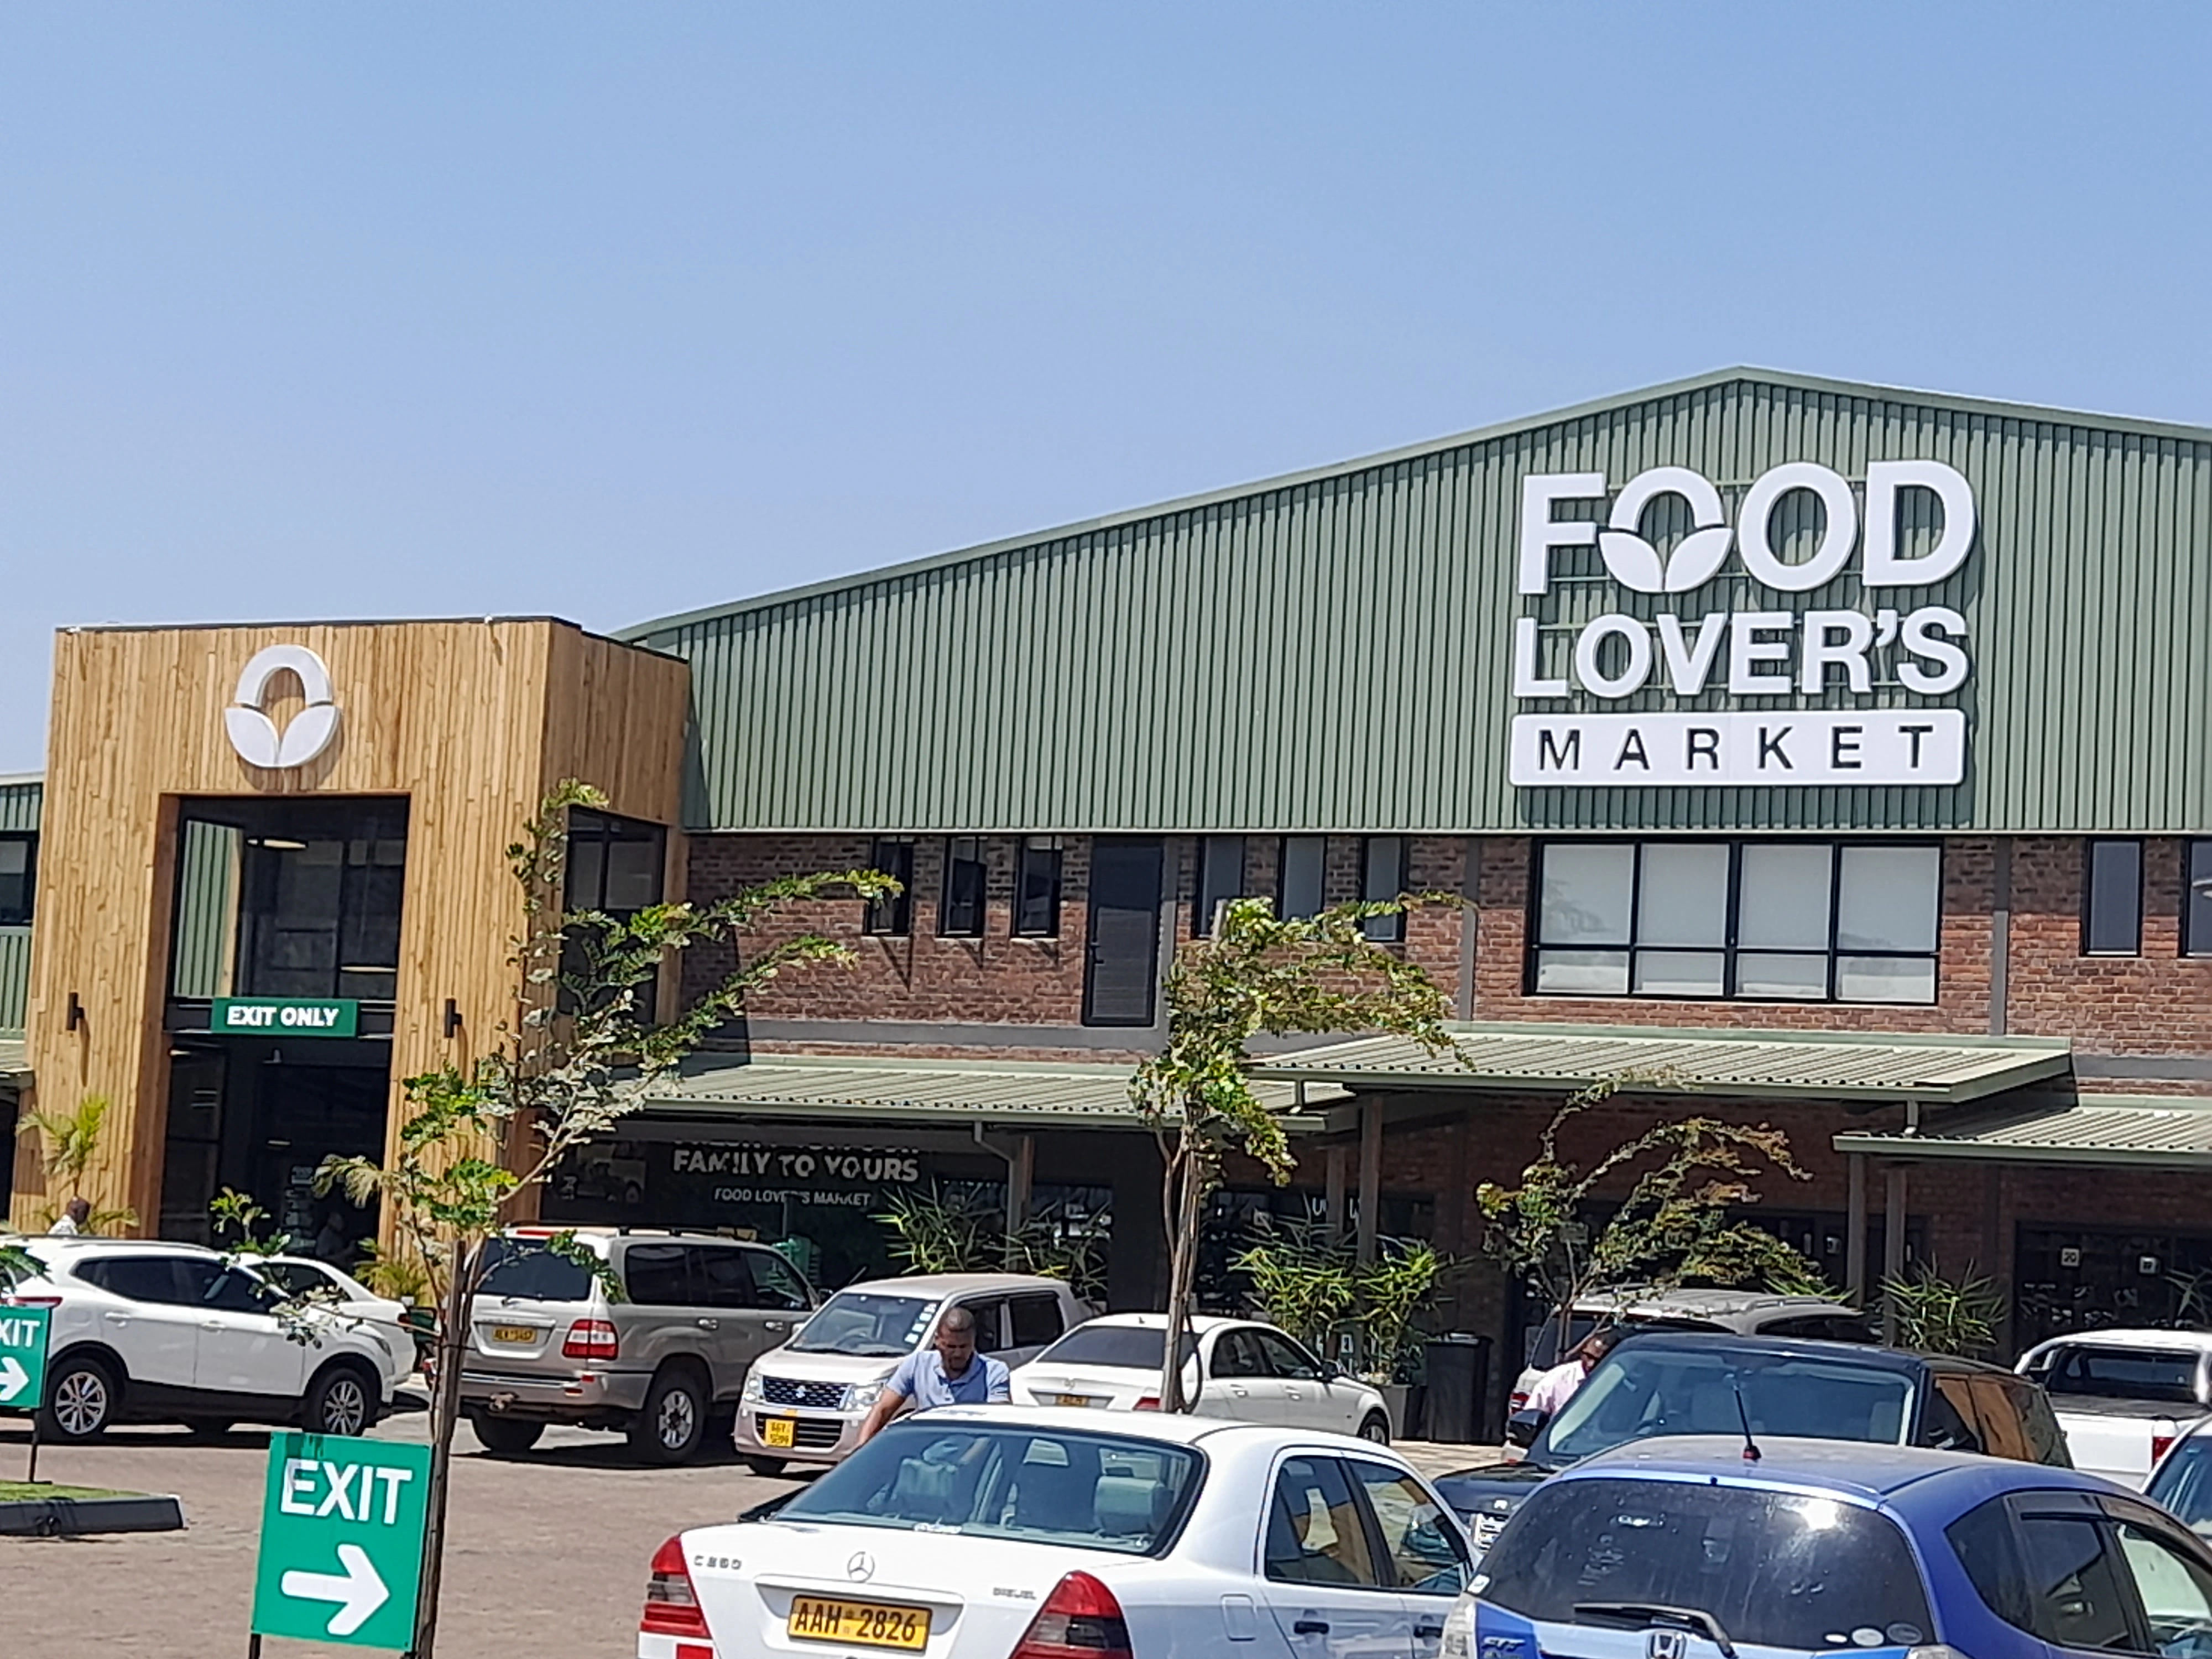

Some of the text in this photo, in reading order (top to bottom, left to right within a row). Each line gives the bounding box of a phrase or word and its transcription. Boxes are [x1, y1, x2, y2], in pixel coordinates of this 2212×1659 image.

[1517, 460, 1976, 594] FOOD
[1513, 606, 1970, 698] LOVER'S
[1538, 726, 1933, 770] MARKET
[227, 1005, 339, 1027] EXIT ONLY
[673, 1149, 919, 1182] FAMILY TO YOURS
[0, 1318, 41, 1348] XIT
[281, 1458, 413, 1525] EXIT
[856, 1608, 916, 1642] 2826
